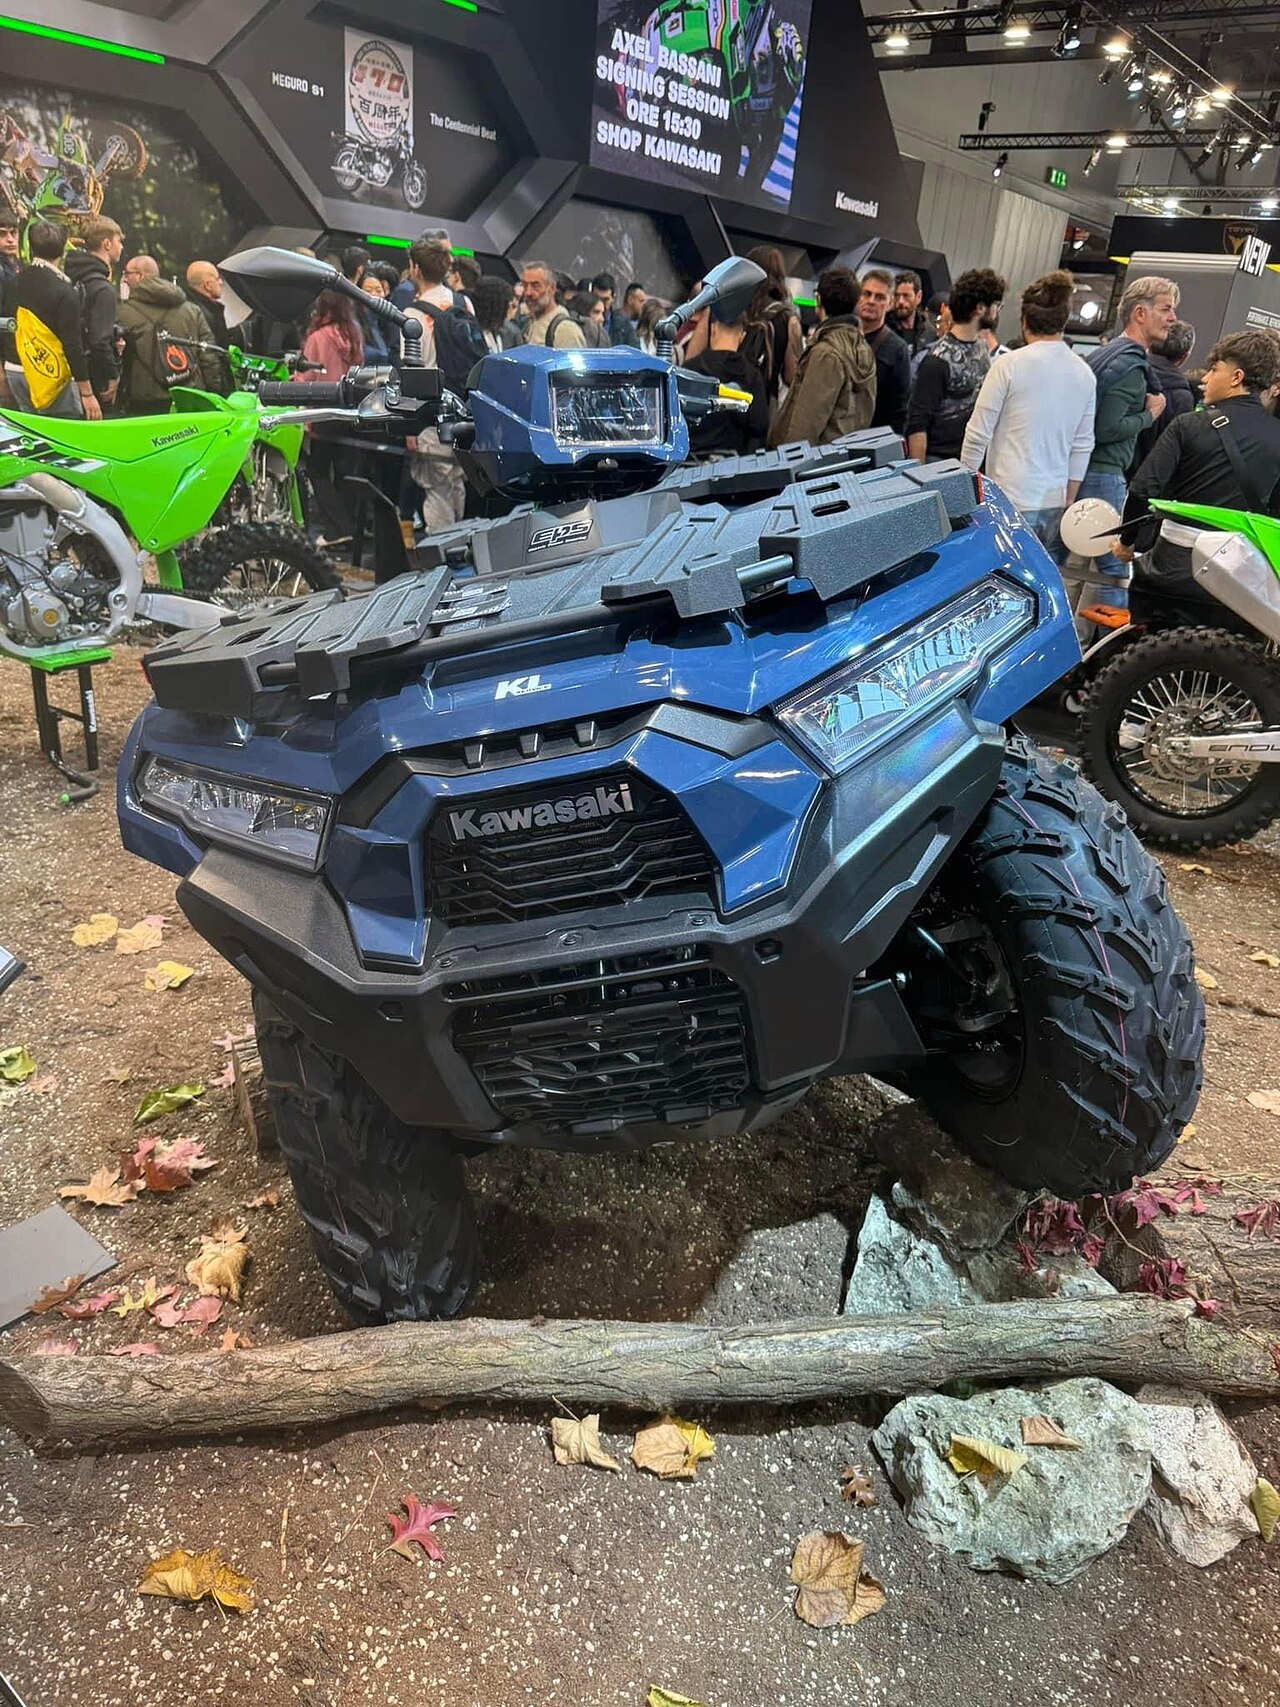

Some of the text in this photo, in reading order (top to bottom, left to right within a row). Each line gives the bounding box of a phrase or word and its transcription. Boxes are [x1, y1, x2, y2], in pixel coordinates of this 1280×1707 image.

[611, 28, 722, 88] AXEL BASSANI
[272, 71, 309, 93] MEGURO
[596, 55, 730, 120] SIGNING SESSION
[429, 112, 444, 128] The
[626, 98, 702, 140] ORE 15:30
[597, 120, 722, 175] SHOP KAWASAKI
[835, 190, 879, 218] Kawasaki
[1239, 234, 1272, 277] NEW
[151, 424, 199, 448] Kawasaki
[530, 519, 594, 546] EPS
[494, 674, 552, 700] KL
[450, 783, 634, 840] Kawasaki
